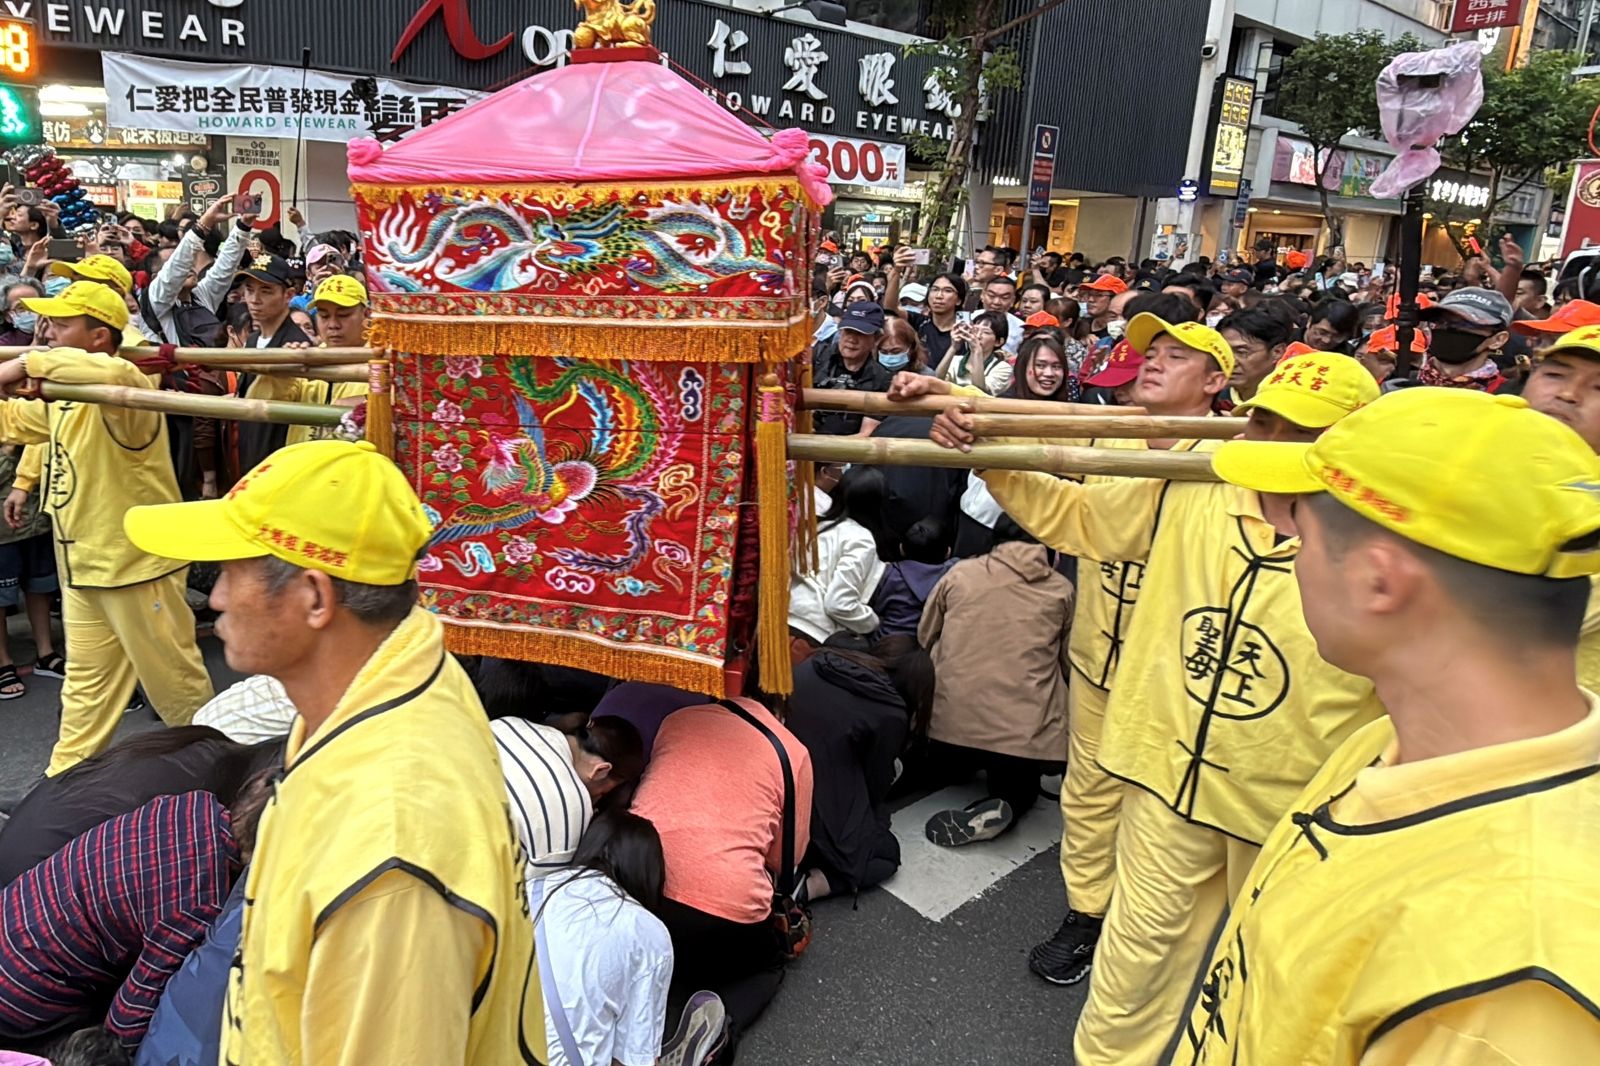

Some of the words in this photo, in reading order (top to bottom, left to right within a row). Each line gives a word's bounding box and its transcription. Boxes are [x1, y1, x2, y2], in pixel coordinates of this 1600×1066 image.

[1465, 10, 1508, 25] 牛排
[0, 24, 30, 72] 8
[125, 83, 361, 115] 仁愛把全民普發現金
[702, 87, 836, 124] HOWARD
[199, 116, 276, 128] HOWARD
[284, 117, 357, 129] EYEWEAR
[1185, 615, 1222, 681] 聖母
[1220, 641, 1267, 708] 天上
